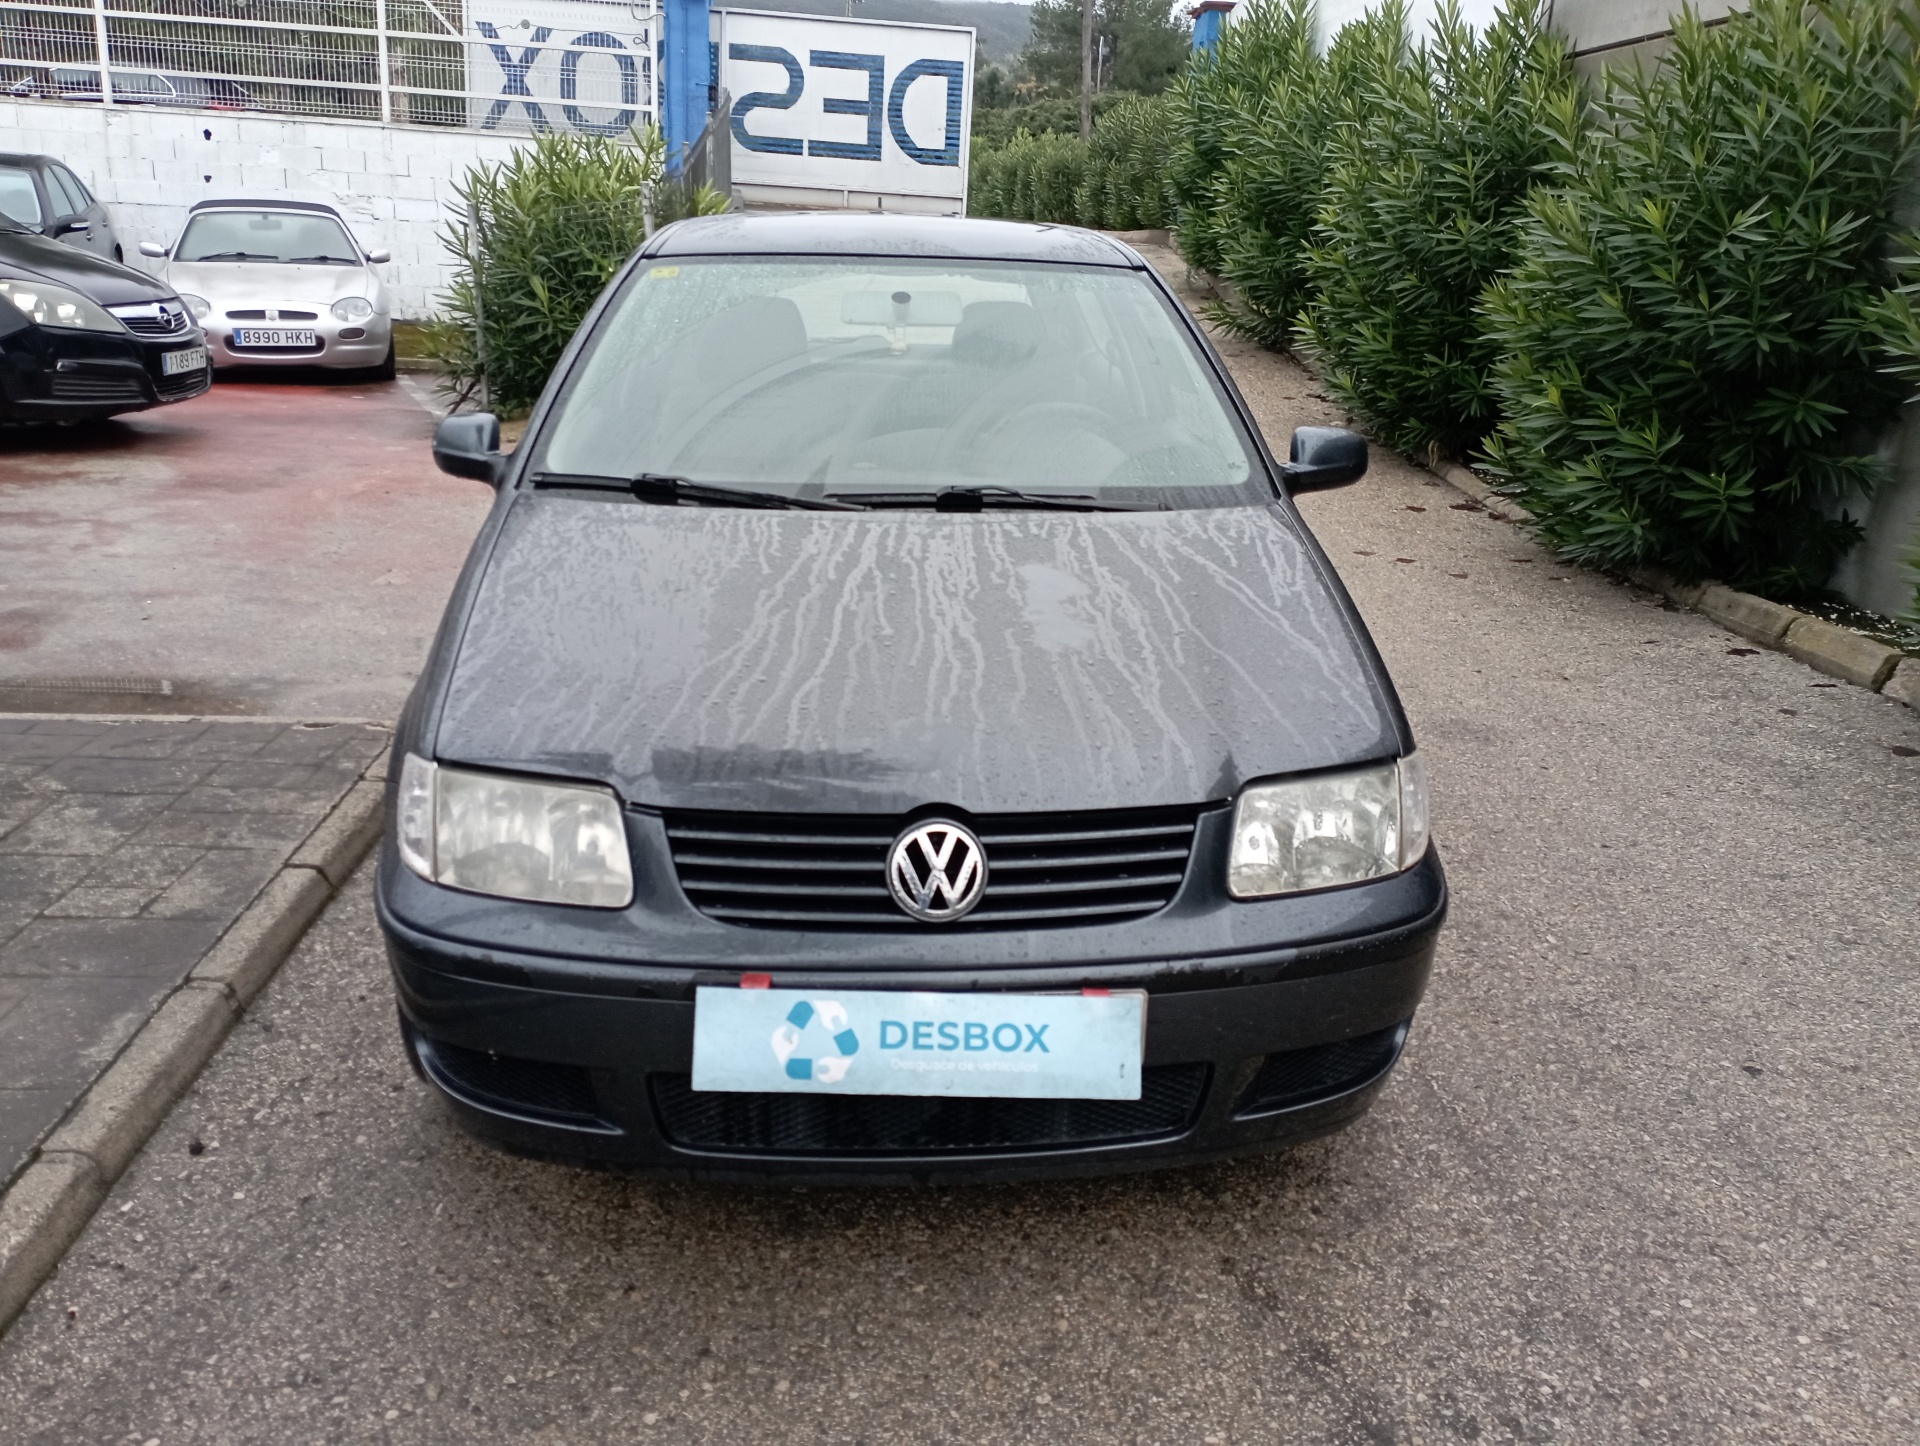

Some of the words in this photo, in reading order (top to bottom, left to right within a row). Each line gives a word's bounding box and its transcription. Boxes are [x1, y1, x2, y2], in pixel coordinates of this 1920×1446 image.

[243, 331, 280, 344] 8990
[285, 331, 313, 344] HKH
[190, 349, 204, 366] FTH
[889, 821, 985, 918] VW
[879, 1020, 1050, 1053] DESBOX
[957, 1060, 975, 1071] de
